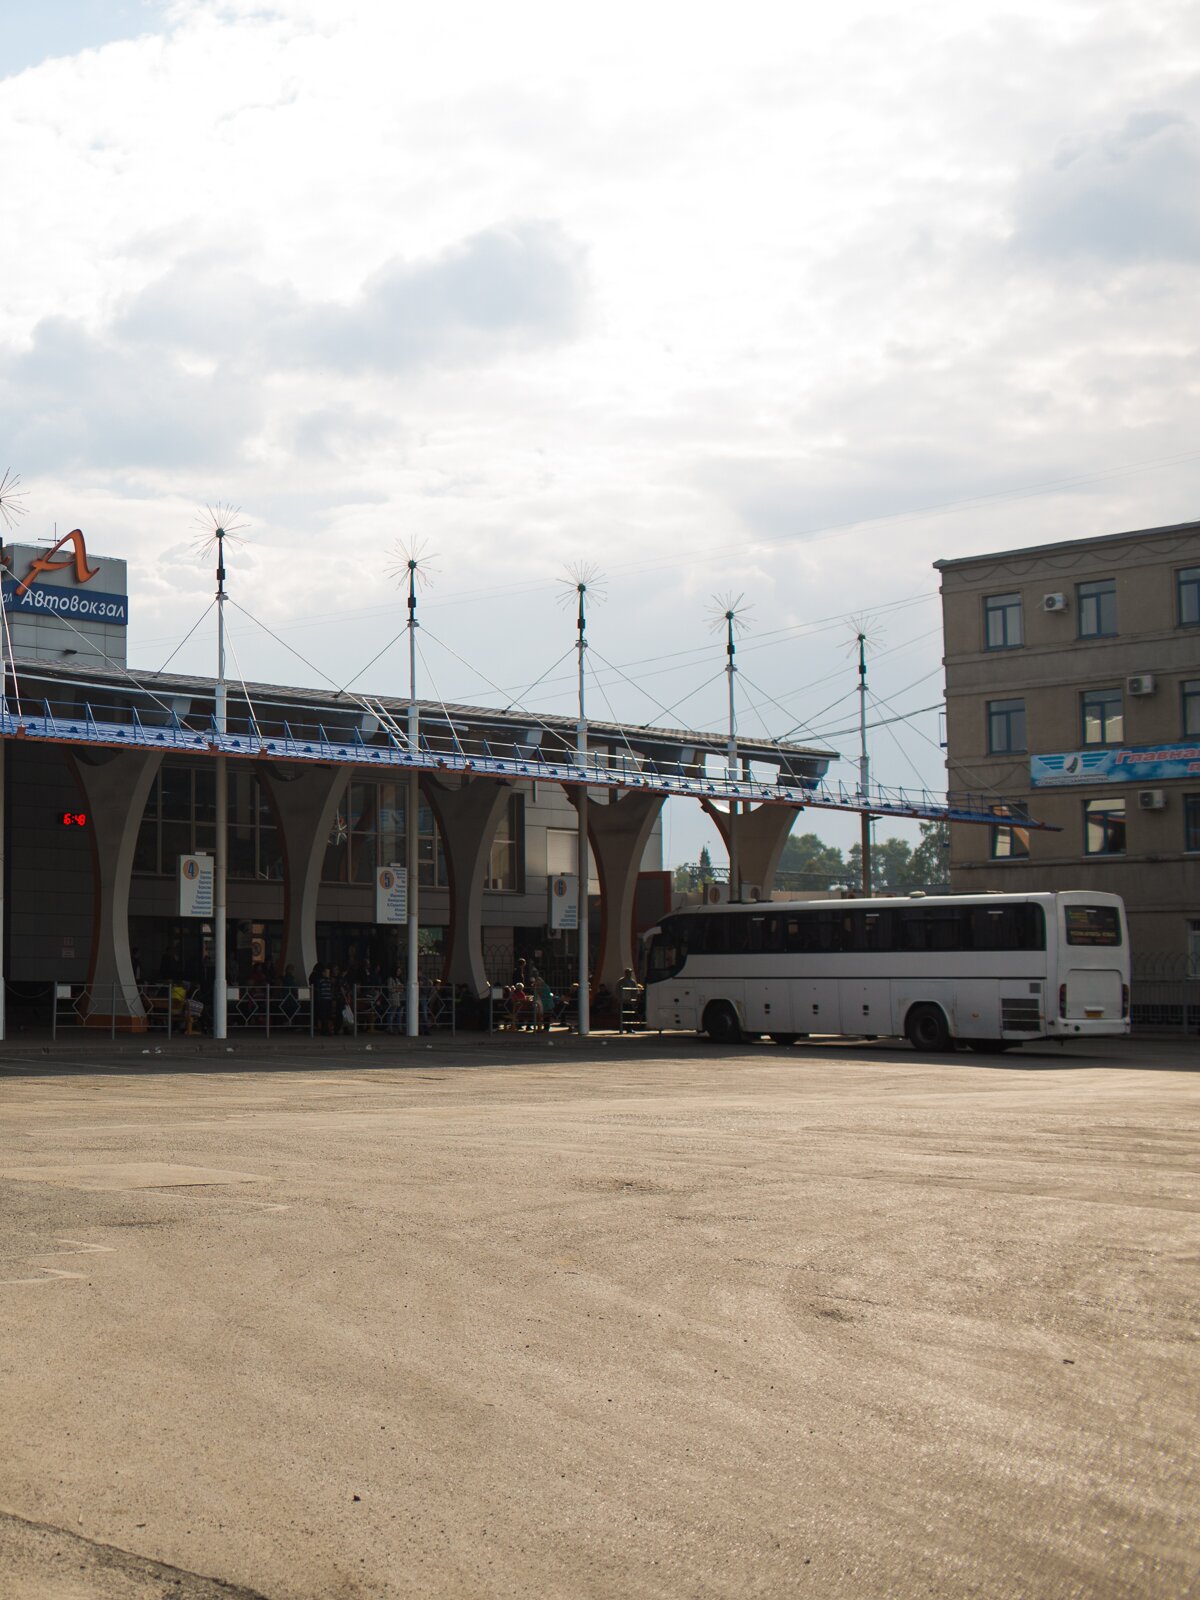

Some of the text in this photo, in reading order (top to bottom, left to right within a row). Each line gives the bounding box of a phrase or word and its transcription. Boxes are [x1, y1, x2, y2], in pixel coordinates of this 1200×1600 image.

[21, 590, 125, 618] Автовокзал
[1116, 749, 1200, 764] Главна
[188, 862, 194, 878] 4
[384, 872, 390, 888] 5
